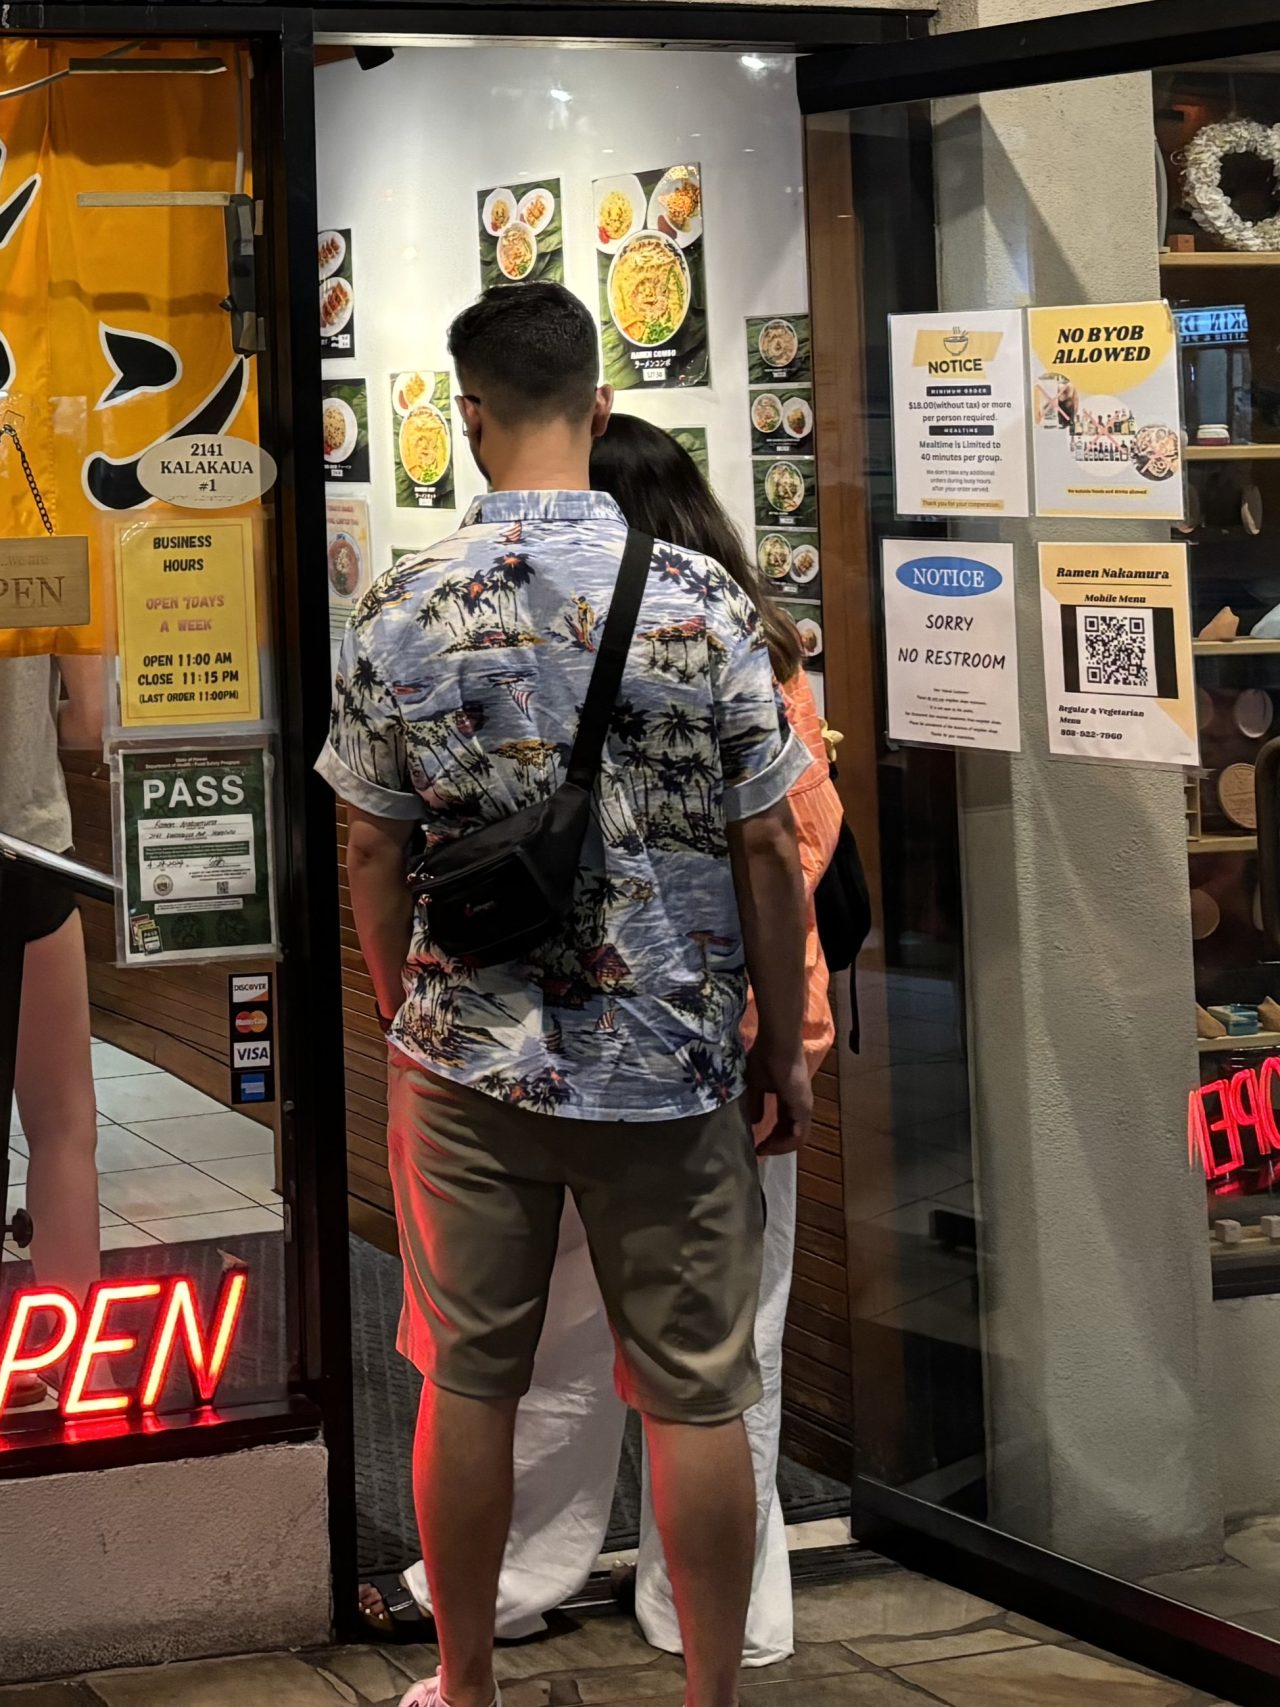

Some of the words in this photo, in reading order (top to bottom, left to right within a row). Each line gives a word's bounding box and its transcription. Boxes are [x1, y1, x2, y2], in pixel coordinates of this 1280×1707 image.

[1057, 327, 1084, 344] NO
[1087, 325, 1144, 343] BYOB
[1052, 346, 1151, 364] ALLOWED
[928, 358, 983, 374] NOTICE
[966, 401, 980, 409] tax)
[922, 415, 935, 423] per
[936, 415, 961, 423] person
[190, 443, 223, 456] 2141
[919, 441, 953, 449] Mealtime
[921, 453, 931, 461] 40
[932, 453, 961, 461] minutes
[963, 455, 975, 463] per
[160, 461, 253, 474] KALAKAUA
[198, 479, 216, 492] #1
[153, 535, 212, 549] BUSINESS
[163, 558, 204, 572] HOURS
[913, 568, 985, 588] NOTICE
[1056, 567, 1099, 578] Ramen
[1101, 567, 1169, 579] Nakamura
[145, 597, 179, 610] OPEN
[1084, 594, 1117, 603] Mobile
[1118, 595, 1146, 603] Menu
[160, 621, 169, 632] A
[178, 619, 212, 632] WEEK
[925, 614, 974, 631] SORRY
[143, 655, 173, 667] OPEN
[178, 653, 211, 666] 11:00
[215, 652, 232, 664] AM
[898, 647, 919, 662] NO
[925, 649, 1006, 670] RESTROOM
[137, 673, 173, 685] CLOSE
[222, 670, 239, 682] PM
[139, 693, 164, 704] (LAST
[167, 692, 195, 702] ORDER
[199, 690, 239, 702] 11:00PM)
[1058, 705, 1088, 714] Regular
[1098, 707, 1144, 717] Vegetarian
[143, 774, 245, 810] PASS
[234, 983, 266, 991] DISCOVER
[237, 1047, 269, 1060] VISA
